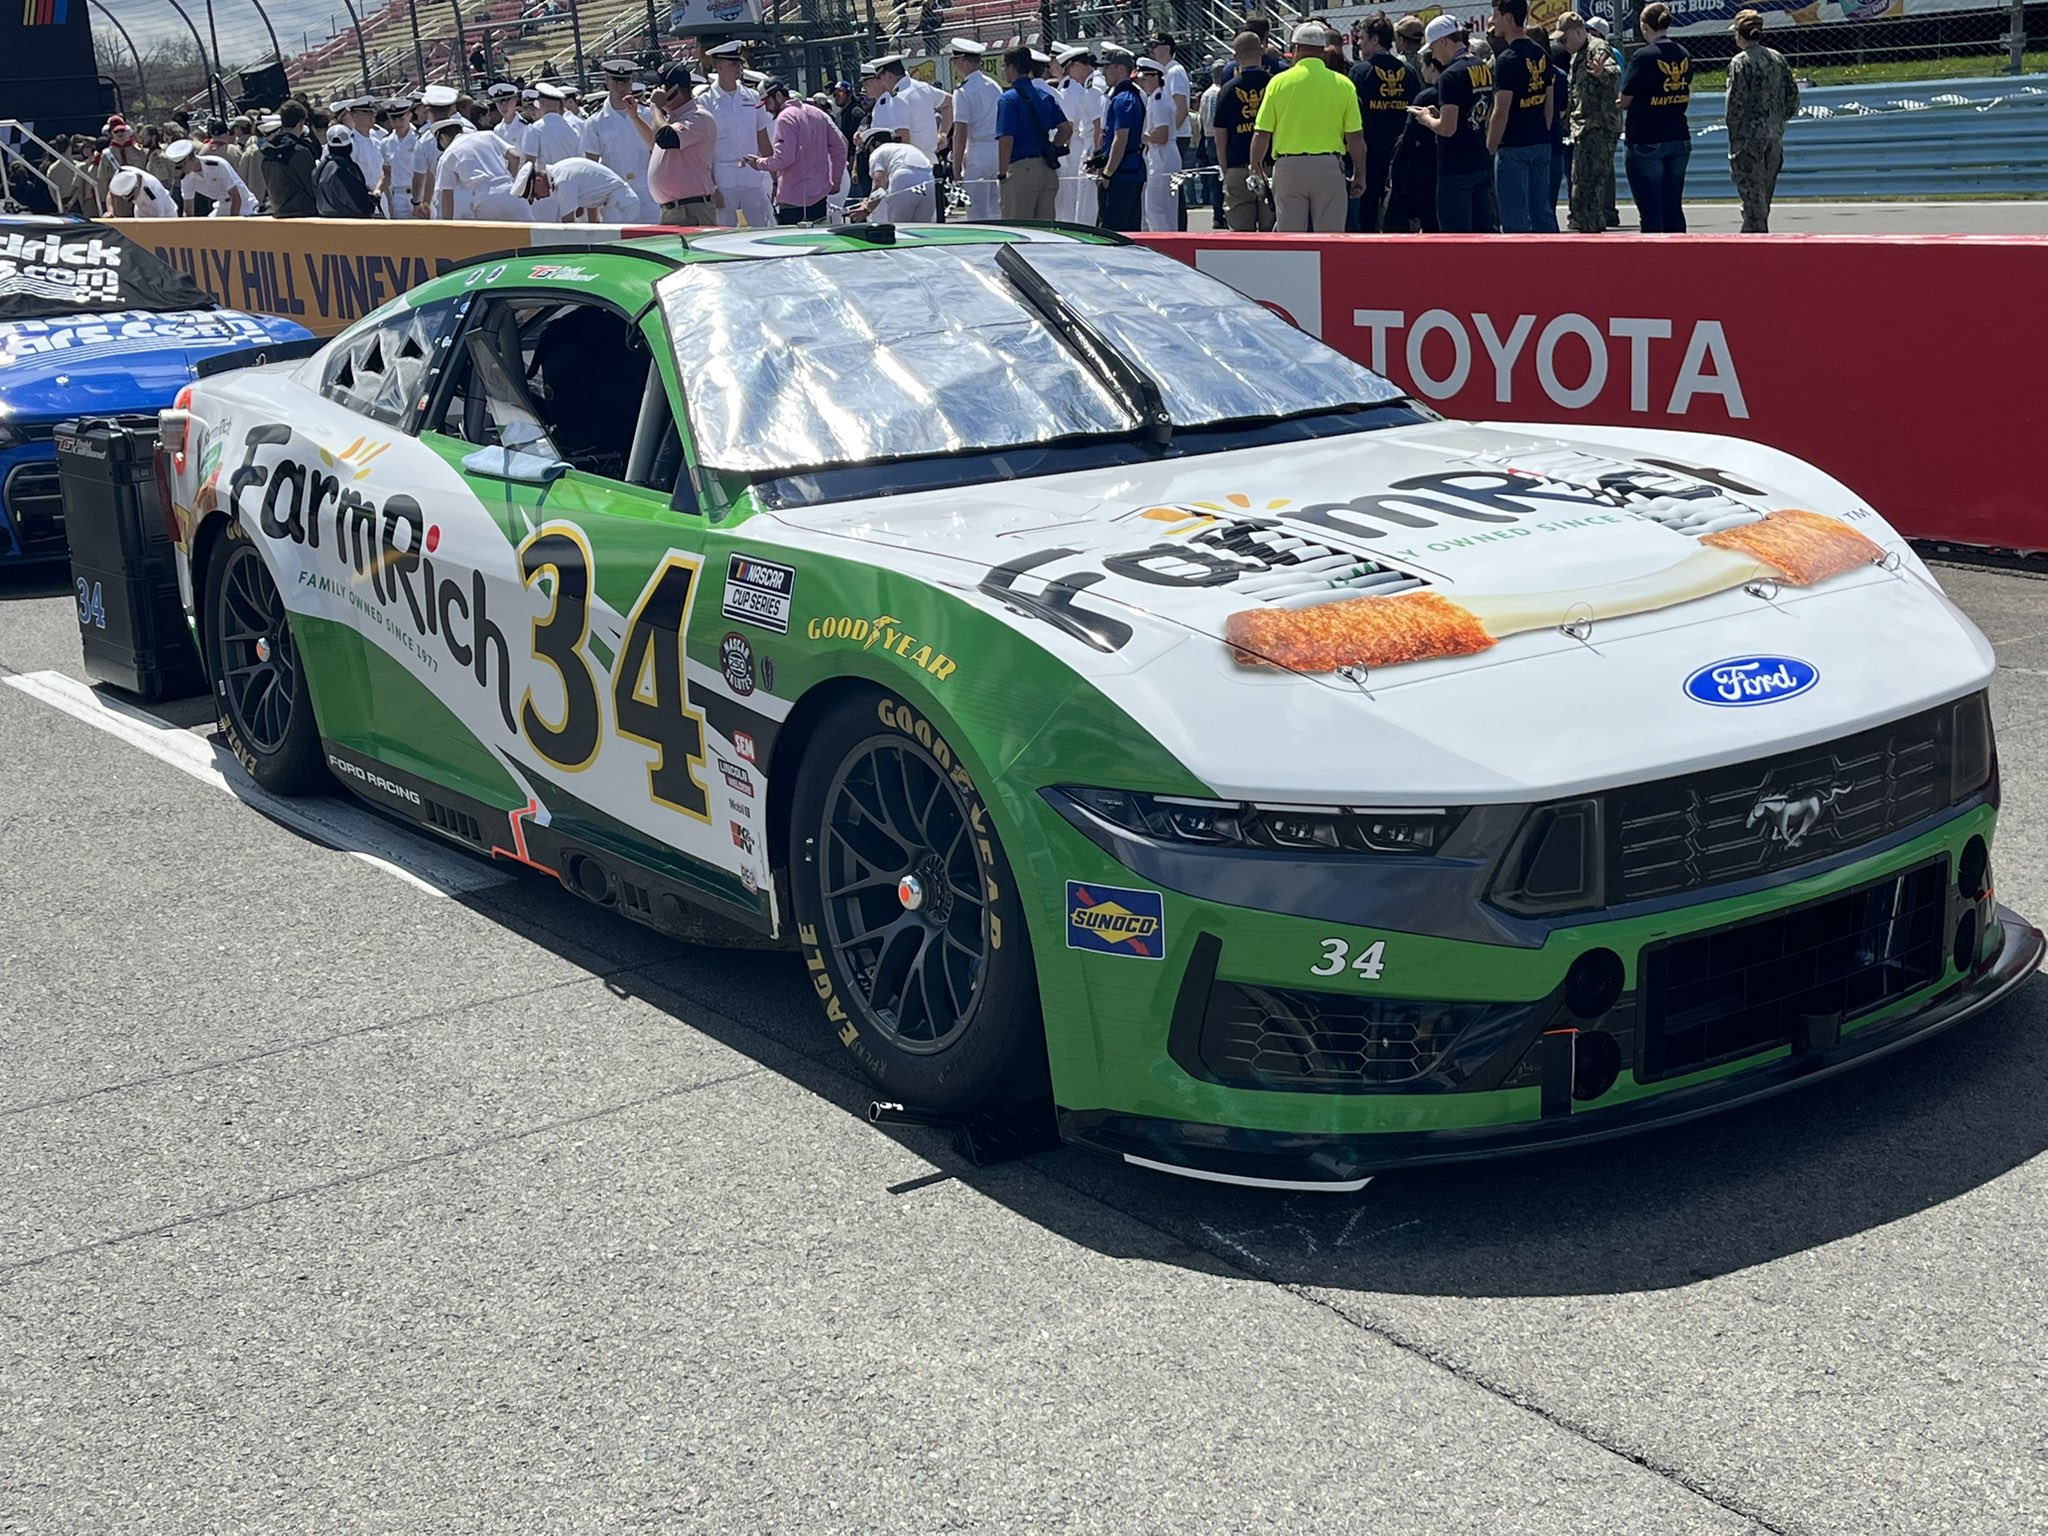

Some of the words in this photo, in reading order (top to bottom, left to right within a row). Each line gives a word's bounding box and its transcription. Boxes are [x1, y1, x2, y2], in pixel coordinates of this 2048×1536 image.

[238, 250, 305, 315] HILL
[1353, 308, 1749, 420] TOYOTA
[1427, 525, 1531, 555] OWNED
[1544, 513, 1621, 533] SINCE
[1842, 506, 1872, 525] TM
[747, 563, 785, 590] NASCAR
[76, 576, 106, 630] 34
[298, 570, 346, 598] FAMILY
[349, 591, 383, 625] OWNED
[385, 616, 414, 650] SINCE
[416, 648, 439, 673] 1977
[732, 588, 750, 607] CUP
[750, 593, 781, 616] SERIES
[723, 635, 750, 659] NASCAR
[729, 654, 747, 673] 250
[807, 614, 958, 683] GOODYEAR
[518, 522, 713, 826] 34
[1712, 661, 1798, 702] Ford
[329, 754, 366, 781] FORD
[367, 771, 421, 805] RACING
[877, 698, 1001, 950] GOODYEAR
[1074, 909, 1156, 935] SUNOCO
[1310, 938, 1386, 980] 34
[799, 921, 860, 1049] EAGLE
